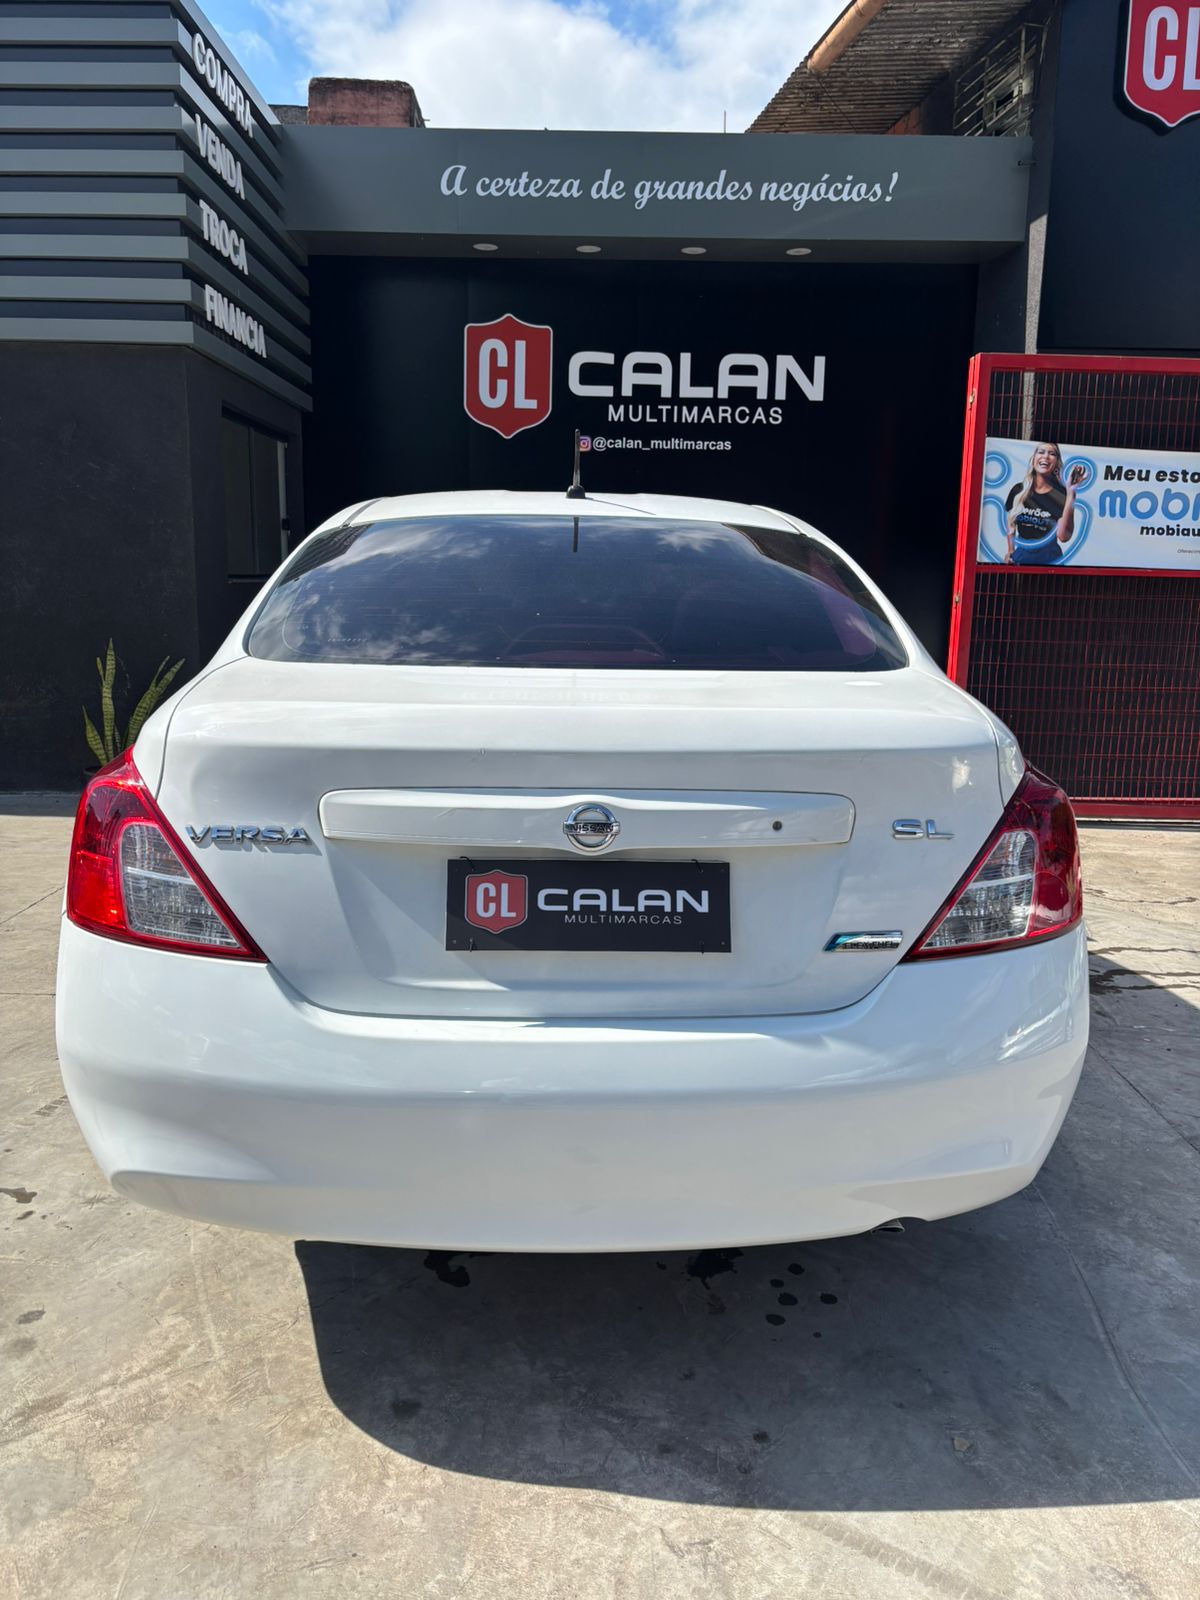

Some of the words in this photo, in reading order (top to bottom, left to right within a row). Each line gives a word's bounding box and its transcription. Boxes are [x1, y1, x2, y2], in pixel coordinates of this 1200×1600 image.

[1142, 5, 1200, 91] CL
[192, 33, 254, 138] COMPRA
[194, 113, 245, 200] VENDA
[440, 164, 468, 197] A
[475, 171, 584, 199] certeza
[590, 168, 625, 200] de
[633, 169, 753, 210] grandes
[759, 172, 899, 212] negócios!
[199, 199, 249, 276] TROCA
[204, 283, 267, 359] FINANCIA
[478, 338, 538, 410] CL
[568, 350, 827, 402] CALAN
[607, 404, 784, 425] MULTIMARCAS
[592, 436, 733, 452] @calan_multimarcas
[1103, 464, 1151, 482] Meu
[184, 824, 313, 845] VERSA
[568, 822, 614, 833] NISSAN
[892, 818, 955, 841] SL
[475, 882, 517, 919] CL
[537, 888, 710, 913] CALAN
[564, 914, 683, 926] MULTIMARCAS
